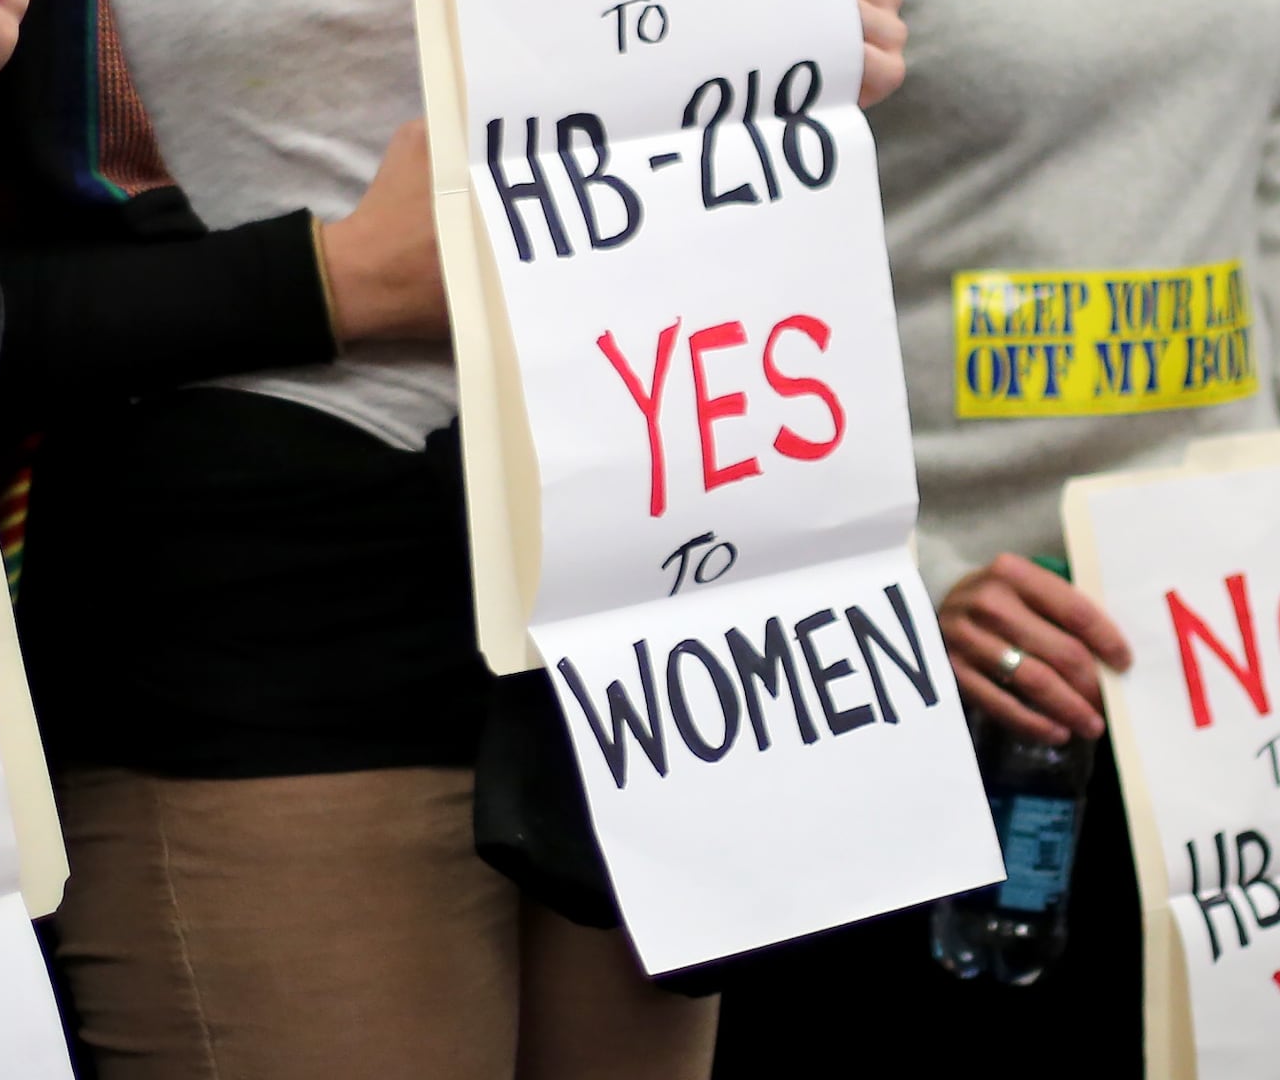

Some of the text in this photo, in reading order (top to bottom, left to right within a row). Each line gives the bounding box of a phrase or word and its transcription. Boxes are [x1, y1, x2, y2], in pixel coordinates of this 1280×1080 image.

[486, 59, 839, 263] HB-218
[966, 343, 1074, 400] OFF
[1094, 340, 1169, 398] MY
[968, 281, 1090, 337] KEEP
[1103, 278, 1193, 335] YOUR
[596, 314, 846, 518] YES
[661, 531, 740, 597] TO
[556, 583, 939, 790] WOMEN
